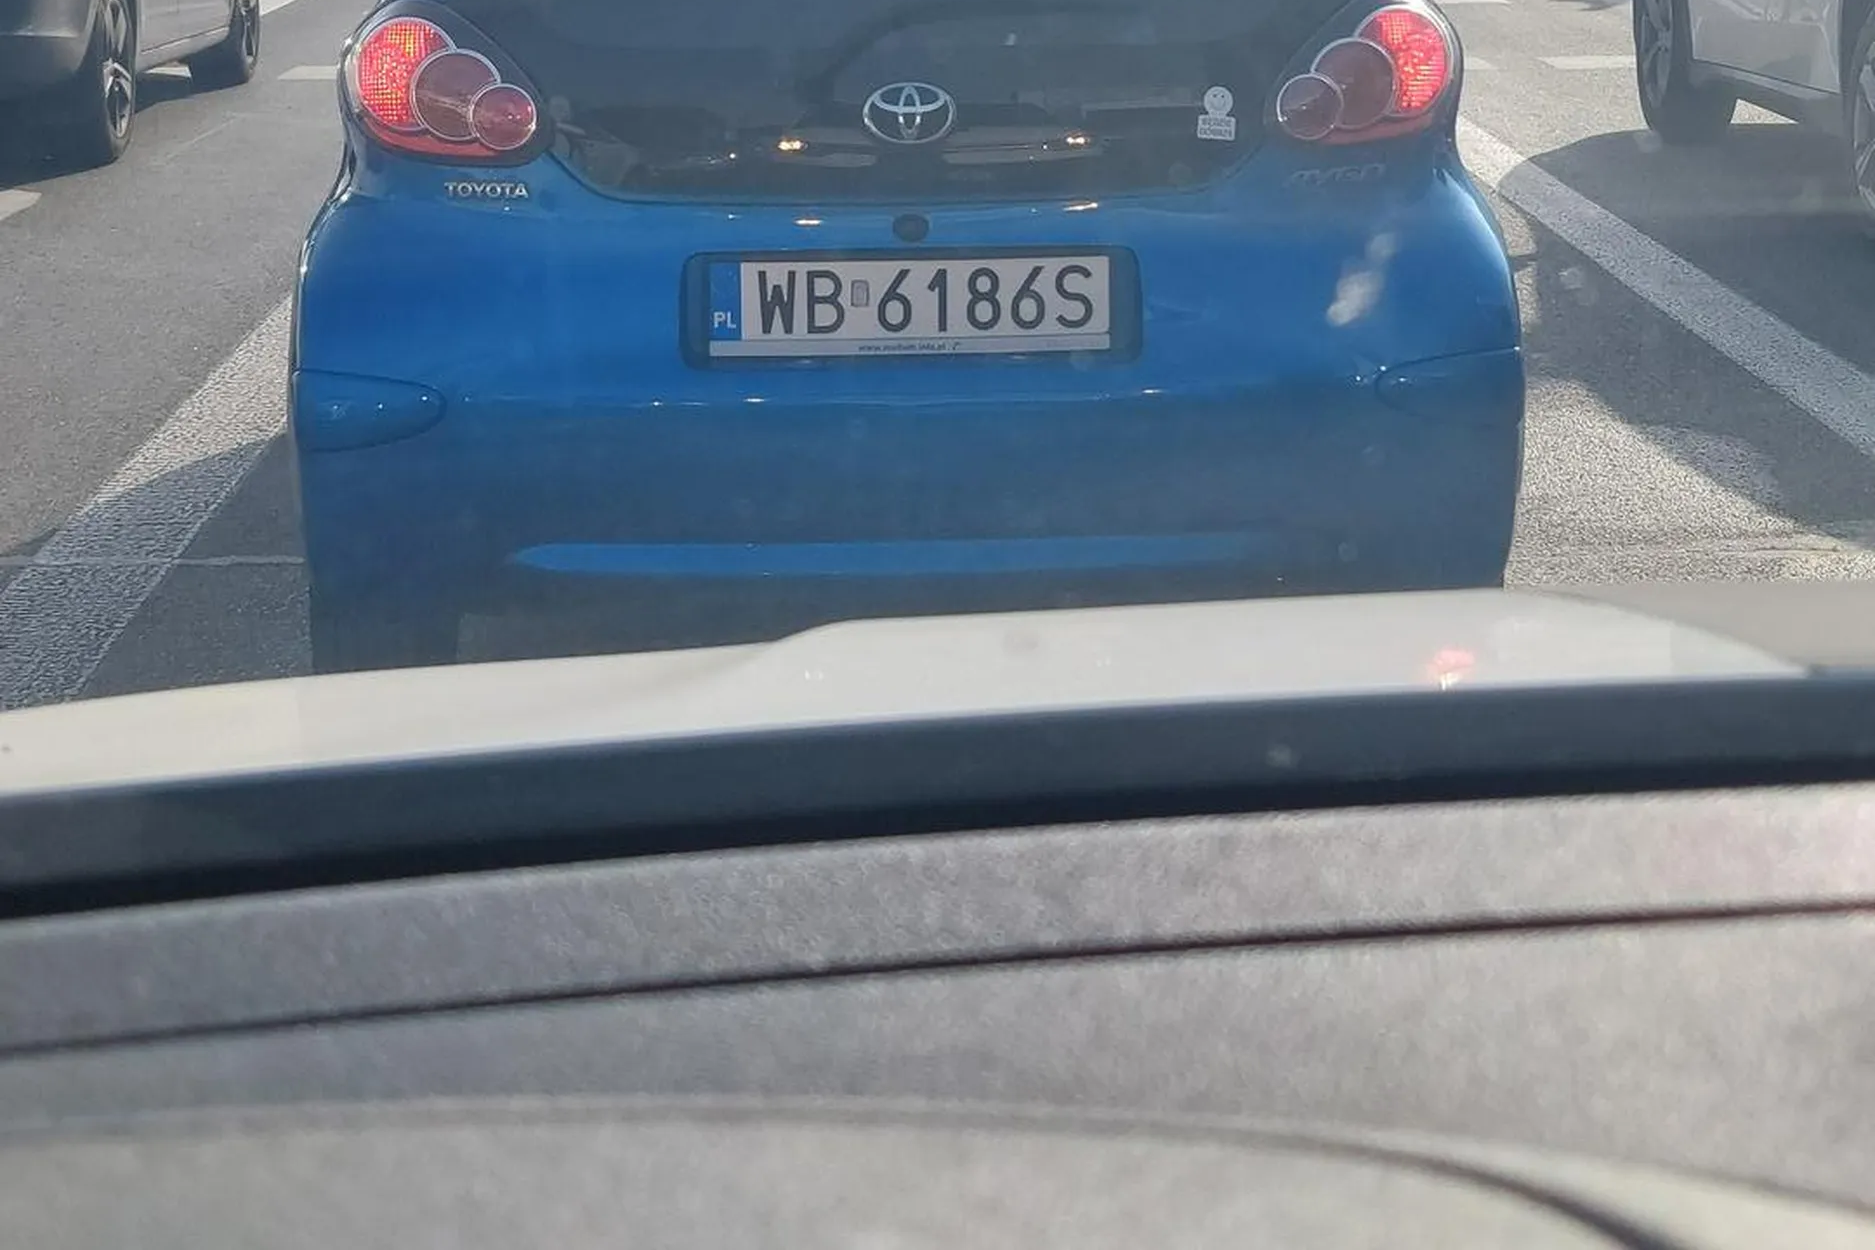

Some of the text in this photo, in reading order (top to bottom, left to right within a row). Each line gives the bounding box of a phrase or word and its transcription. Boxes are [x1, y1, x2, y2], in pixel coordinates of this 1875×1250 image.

[443, 181, 529, 199] TOYOTA
[757, 264, 1094, 335] WB 6186S
[713, 311, 737, 329] PL
